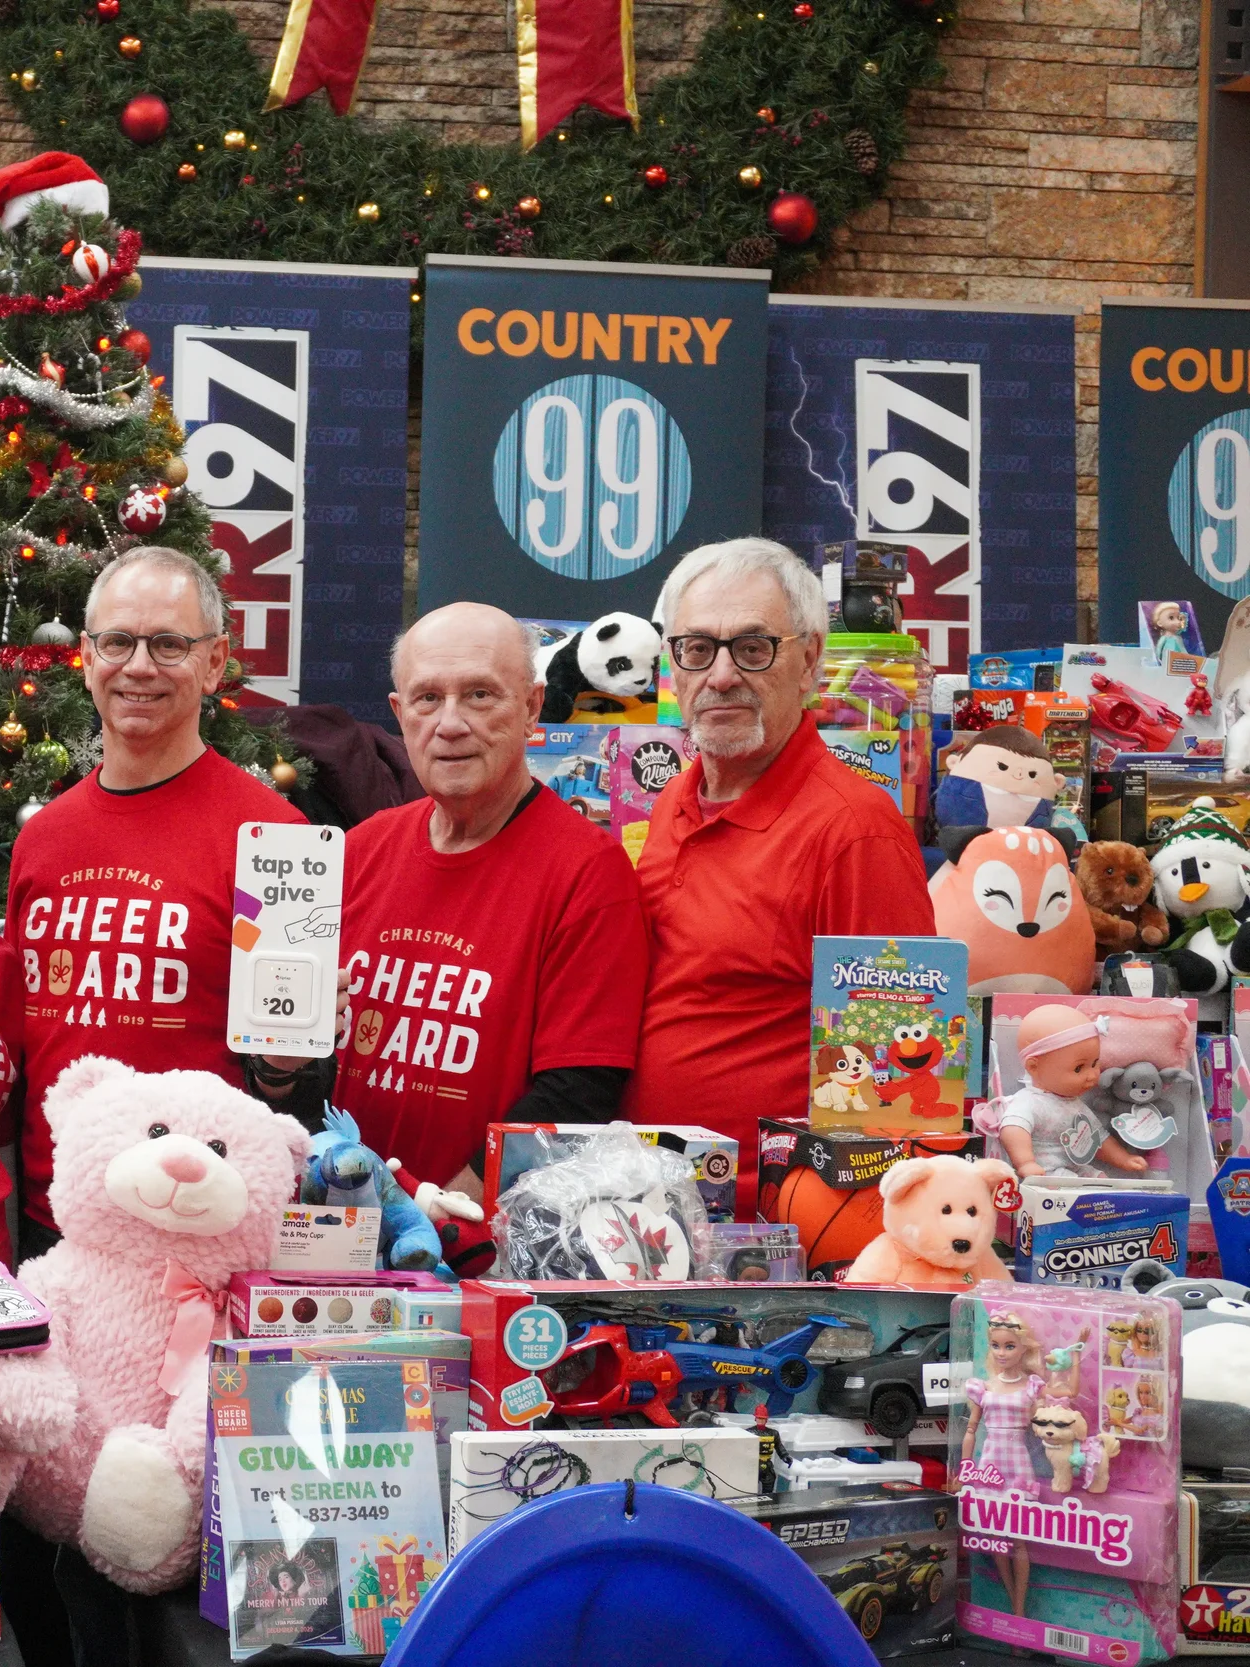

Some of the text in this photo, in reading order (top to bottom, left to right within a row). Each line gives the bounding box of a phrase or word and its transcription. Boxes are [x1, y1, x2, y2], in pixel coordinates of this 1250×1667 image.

[458, 308, 732, 365] COUNTRY
[1130, 346, 1250, 394] COU
[525, 395, 659, 560] 99
[1048, 710, 1083, 718] MATCHBOX
[550, 732, 574, 743] CITY
[639, 755, 669, 767] COMPOUND
[641, 762, 678, 788] Kings
[252, 854, 327, 879] tap to
[60, 869, 164, 891] CHRISTMAS
[263, 881, 315, 906] give
[25, 896, 189, 950] CHEER
[379, 928, 474, 956] CHRISTMAS
[838, 955, 852, 964] THE
[346, 950, 492, 1018] CHEER
[263, 997, 295, 1016] $20
[41, 1008, 145, 1026] EST. 1919
[411, 1081, 434, 1094] 1919
[850, 1143, 904, 1167] SILENT PLAY
[838, 1170, 854, 1182] JEU
[282, 1221, 310, 1229] amaze
[296, 1231, 309, 1239] Play
[310, 1231, 324, 1239] Cups
[1048, 1239, 1150, 1271] CONNECT
[1150, 1226, 1174, 1260] 4
[519, 1317, 554, 1342] 31
[723, 1364, 751, 1374] RESCUE
[506, 1381, 537, 1398] TRY ME!
[217, 1409, 246, 1418] CHEER
[218, 1418, 248, 1427] BOARD
[959, 1460, 1004, 1486] Barbie
[290, 1481, 377, 1501] SERENA
[381, 1481, 402, 1498] to
[779, 1518, 850, 1544] SPEED
[960, 1491, 1129, 1562] twinning
[803, 1536, 847, 1547] CHAMPIONS
[962, 1536, 1008, 1553] LOOKS
[247, 1597, 328, 1609] MERRY MYTHS TOUR
